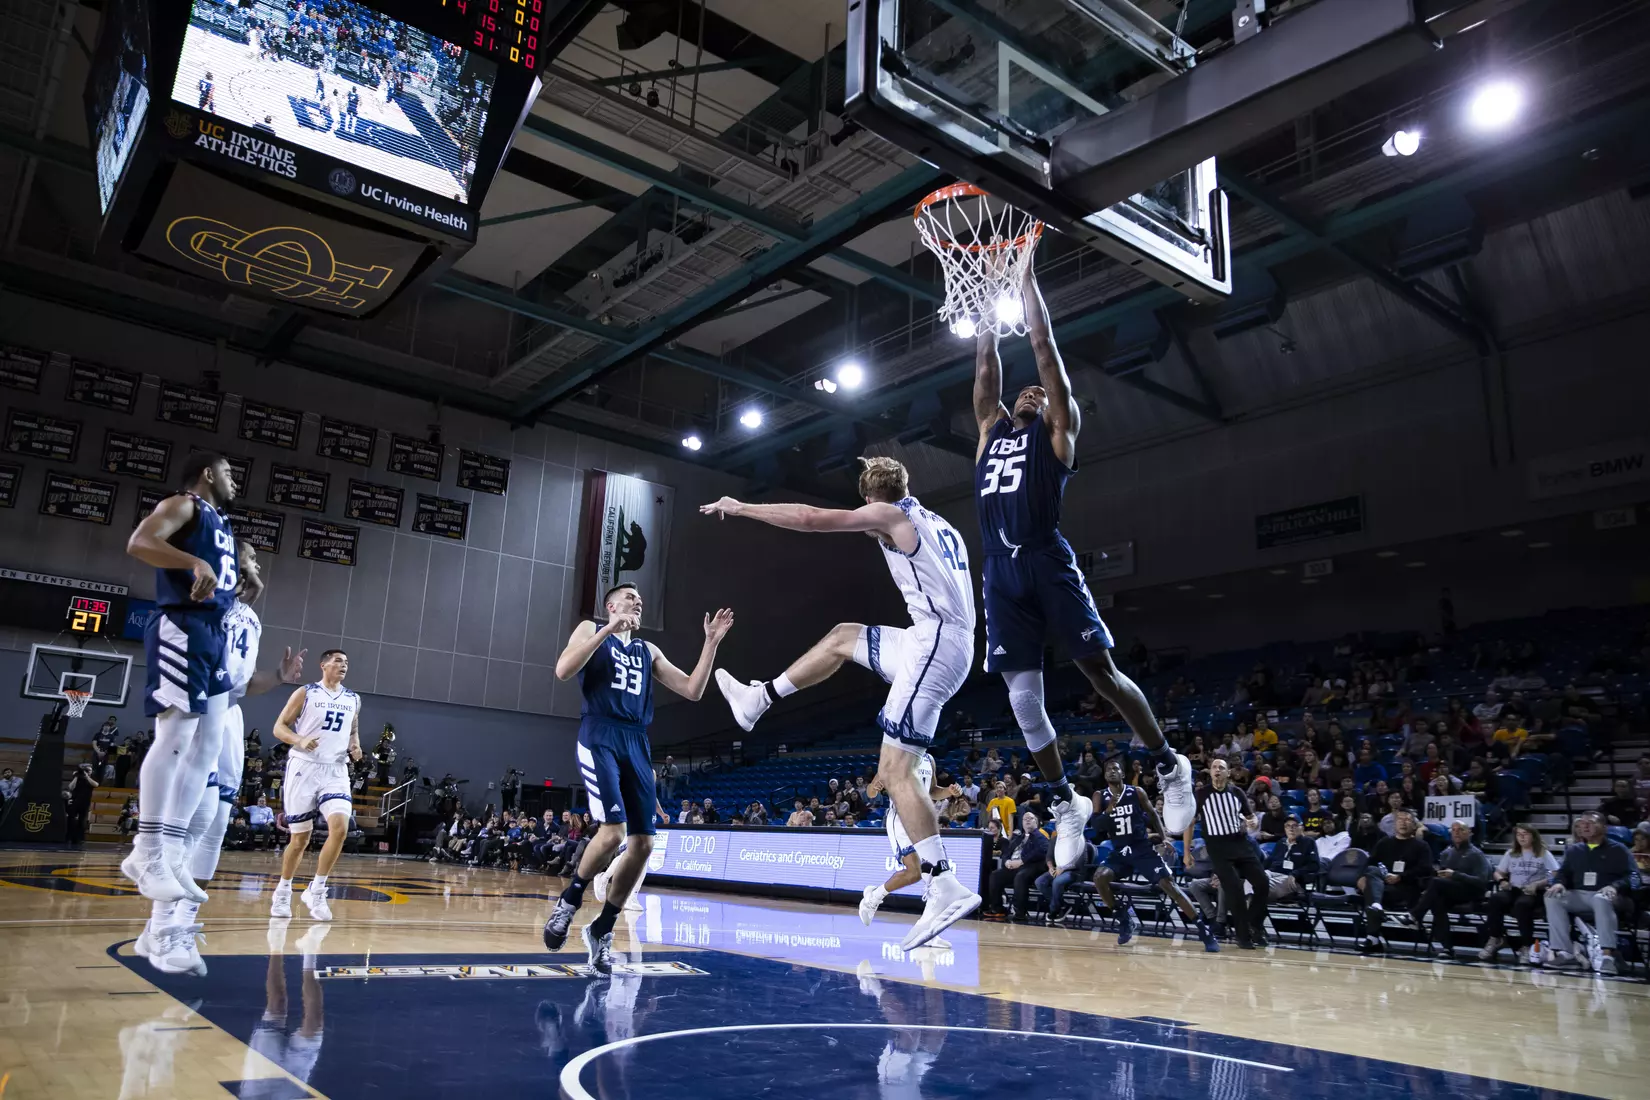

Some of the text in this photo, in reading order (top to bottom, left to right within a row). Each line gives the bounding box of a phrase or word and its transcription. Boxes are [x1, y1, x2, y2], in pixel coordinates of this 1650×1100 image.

[482, 14, 496, 32] 15
[199, 119, 296, 165] UC IRVINE
[194, 134, 298, 179] ATHLETICS
[360, 183, 468, 231] UC Irvine Health
[988, 433, 1029, 456] CBU
[980, 454, 1027, 498] 35
[1591, 454, 1645, 478] BMW
[601, 506, 616, 584] CALIFORNIA REPUBLIC
[936, 528, 967, 571] 42
[26, 573, 73, 586] EVENTS
[80, 581, 124, 594] CENTER
[218, 555, 237, 591] 15
[76, 598, 107, 612] 17:35
[72, 611, 102, 633] 27
[230, 624, 249, 659] 14
[611, 646, 643, 669] CBU
[610, 663, 643, 696] 33
[314, 701, 354, 713] UC IRVINE
[321, 710, 345, 732] 55
[1109, 803, 1133, 819] CBU
[1427, 802, 1446, 820] Rip
[1114, 817, 1133, 836] 31
[680, 835, 702, 853] TOP
[703, 836, 716, 854] 10
[675, 860, 712, 872] in California
[739, 848, 845, 870] Geriatrics and Gynecology
